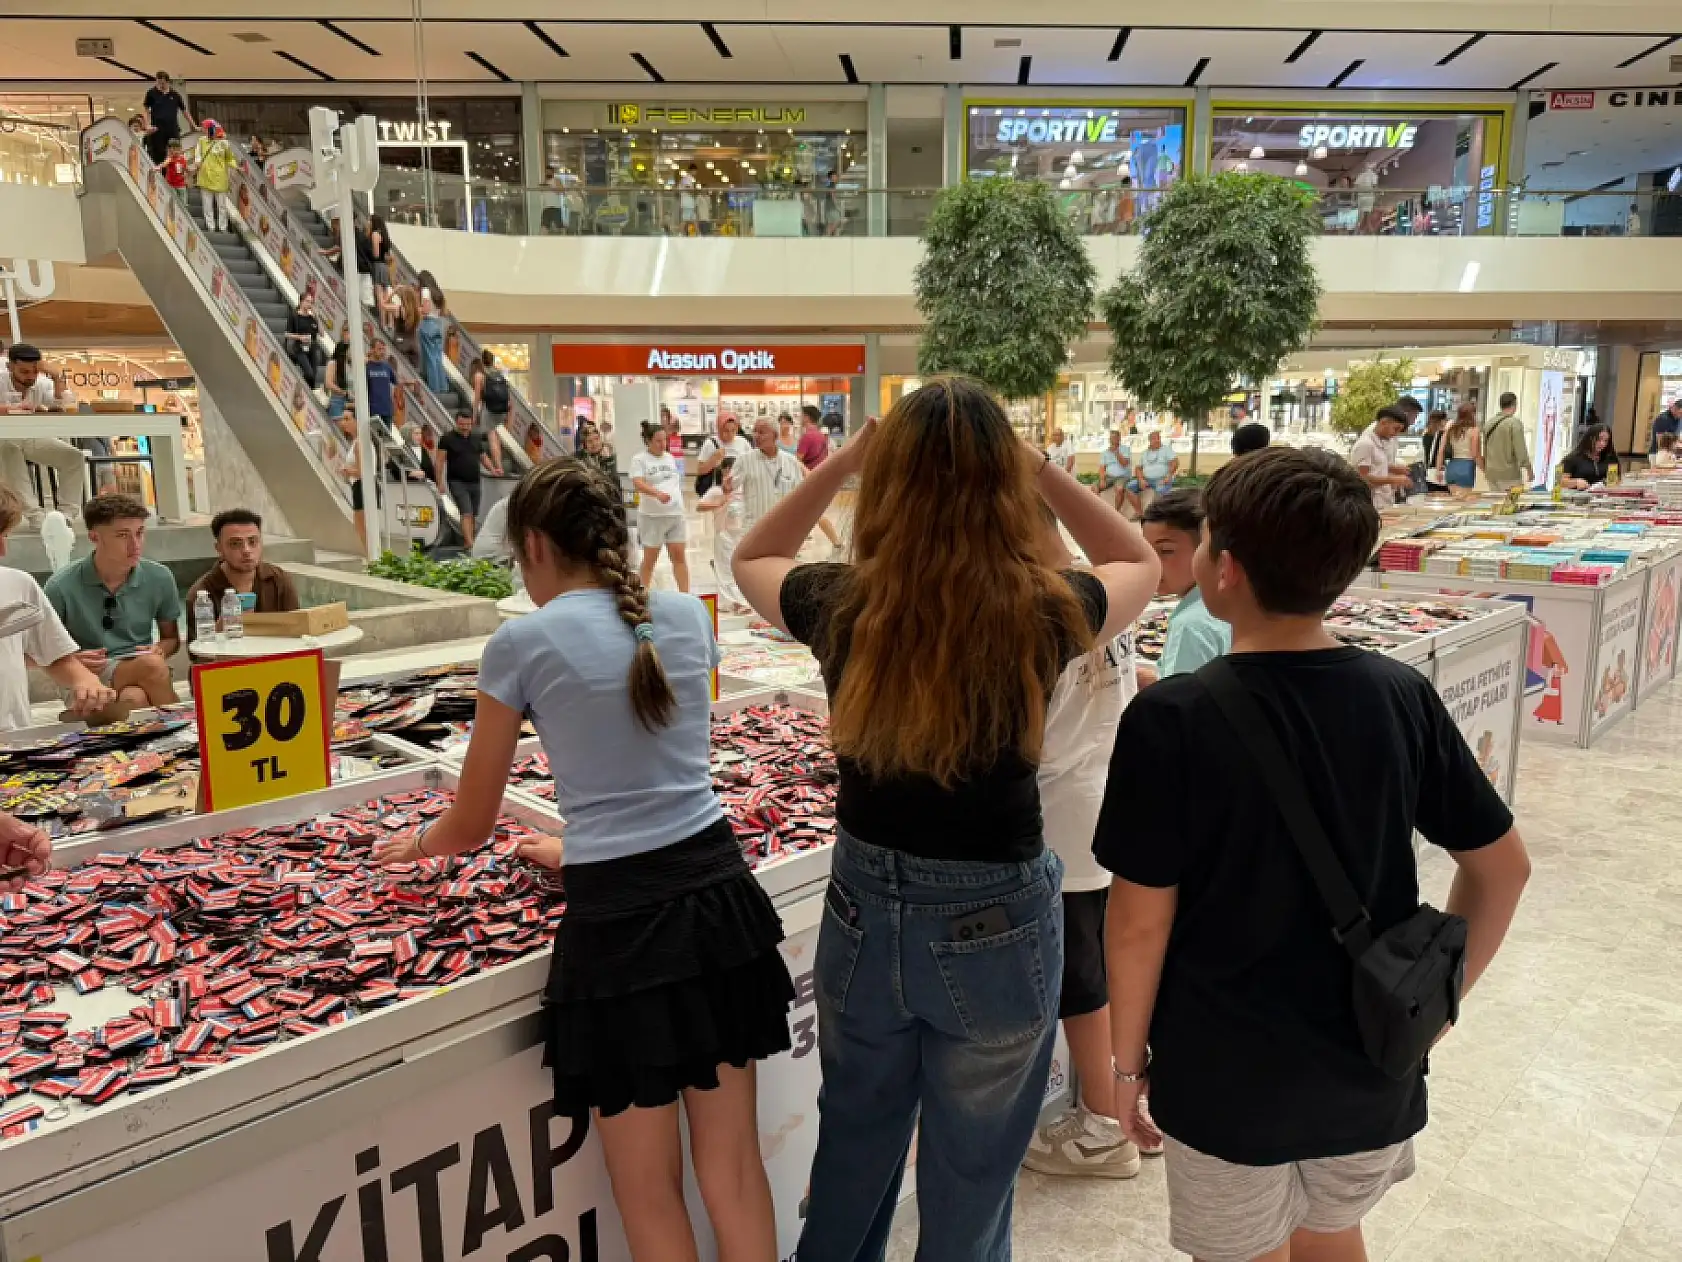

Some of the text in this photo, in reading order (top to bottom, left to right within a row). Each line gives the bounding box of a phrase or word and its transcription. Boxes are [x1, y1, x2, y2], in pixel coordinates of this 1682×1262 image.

[646, 107, 805, 124] FENERIUM
[997, 115, 1118, 142] SPORTIVE
[378, 120, 451, 141] TWIST
[1299, 121, 1417, 148] SPORTIVE
[648, 348, 775, 374] Atasun Optik
[221, 681, 306, 752] 30
[250, 755, 288, 783] TL
